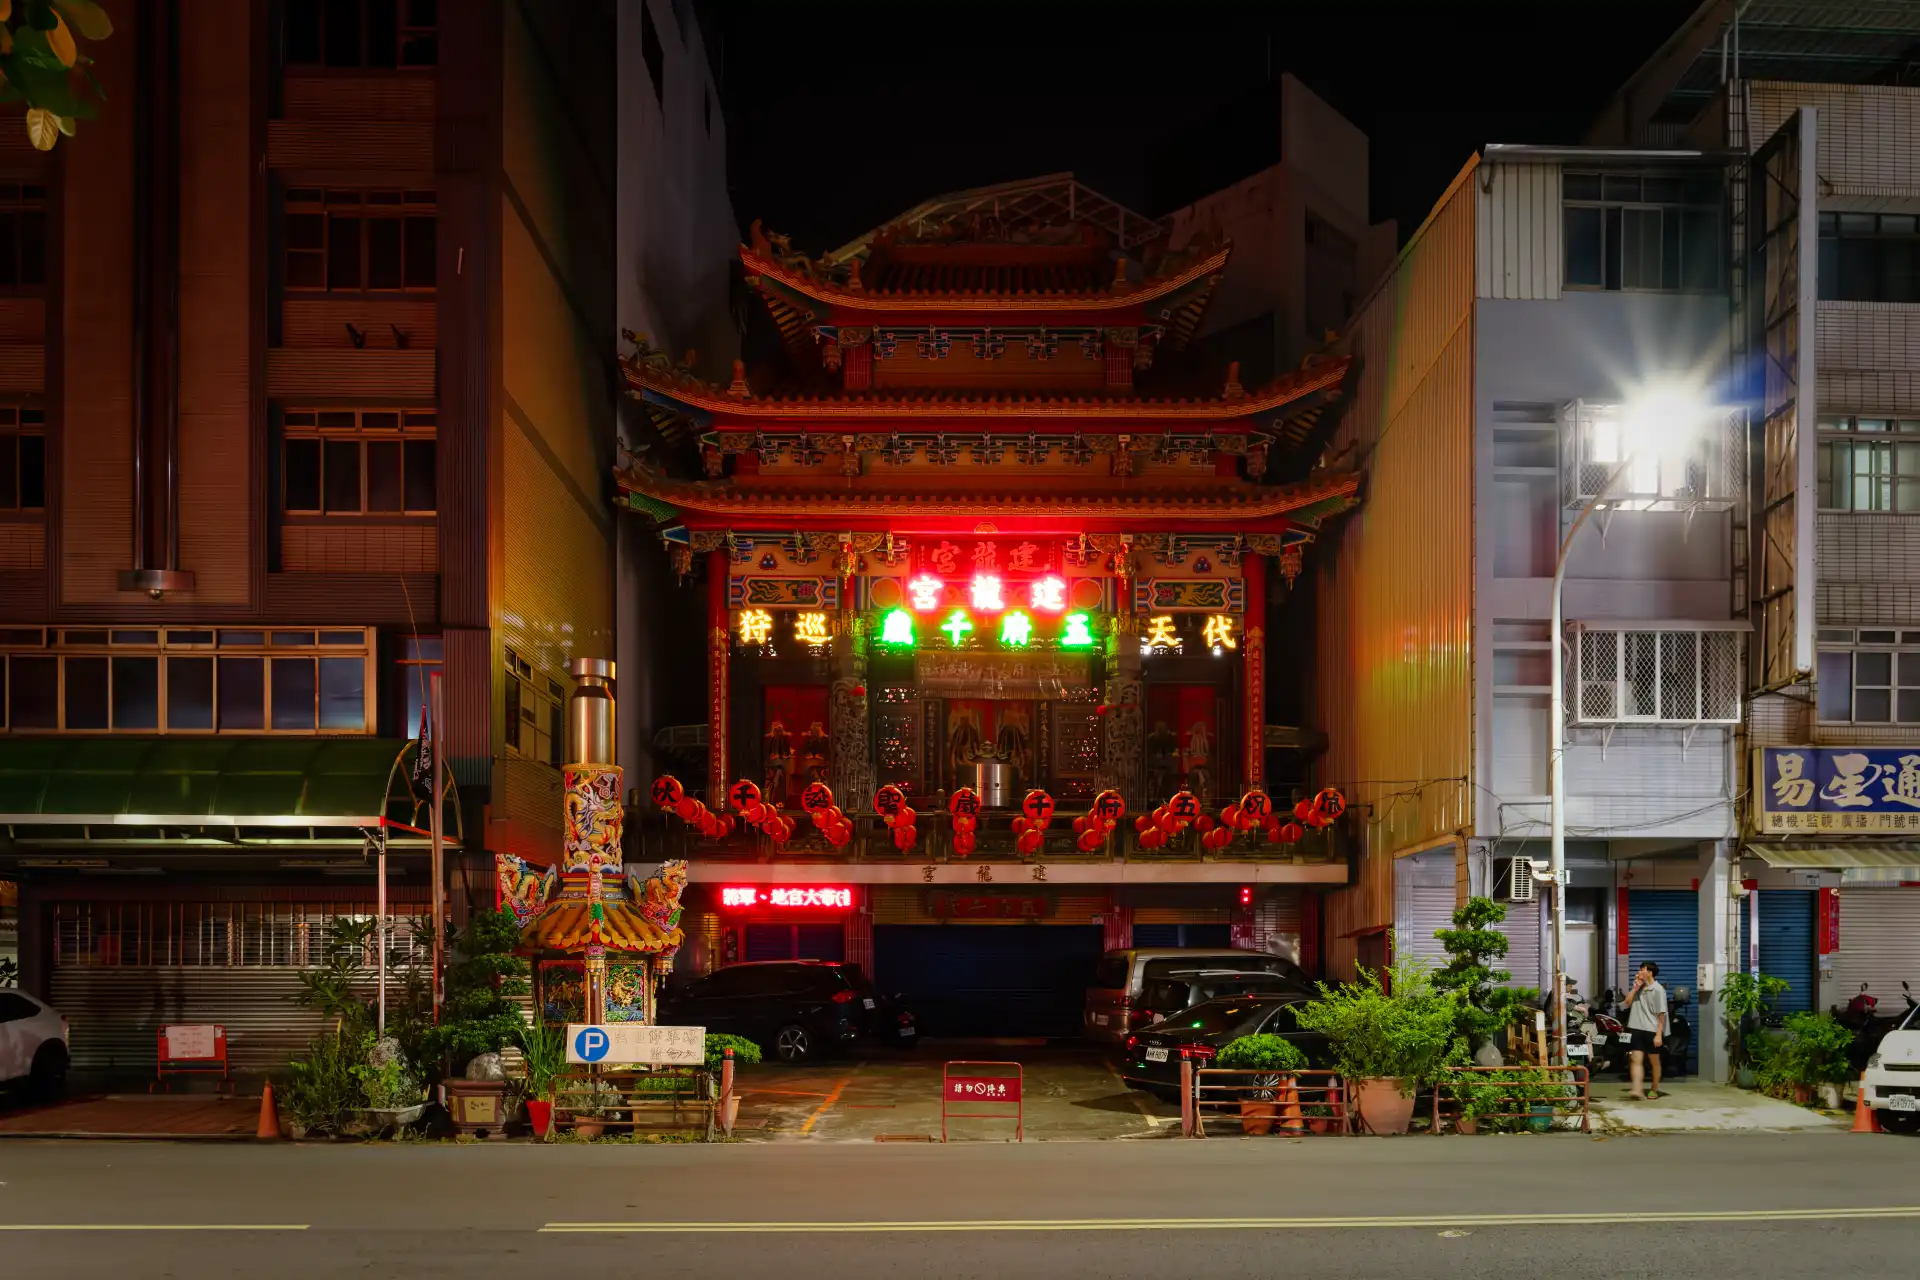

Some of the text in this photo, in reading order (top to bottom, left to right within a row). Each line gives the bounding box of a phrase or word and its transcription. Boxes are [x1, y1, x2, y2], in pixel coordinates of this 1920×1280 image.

[739, 609, 829, 644] 巡狩
[1147, 614, 1237, 649] 代天
[1772, 753, 1920, 808] 易星通
